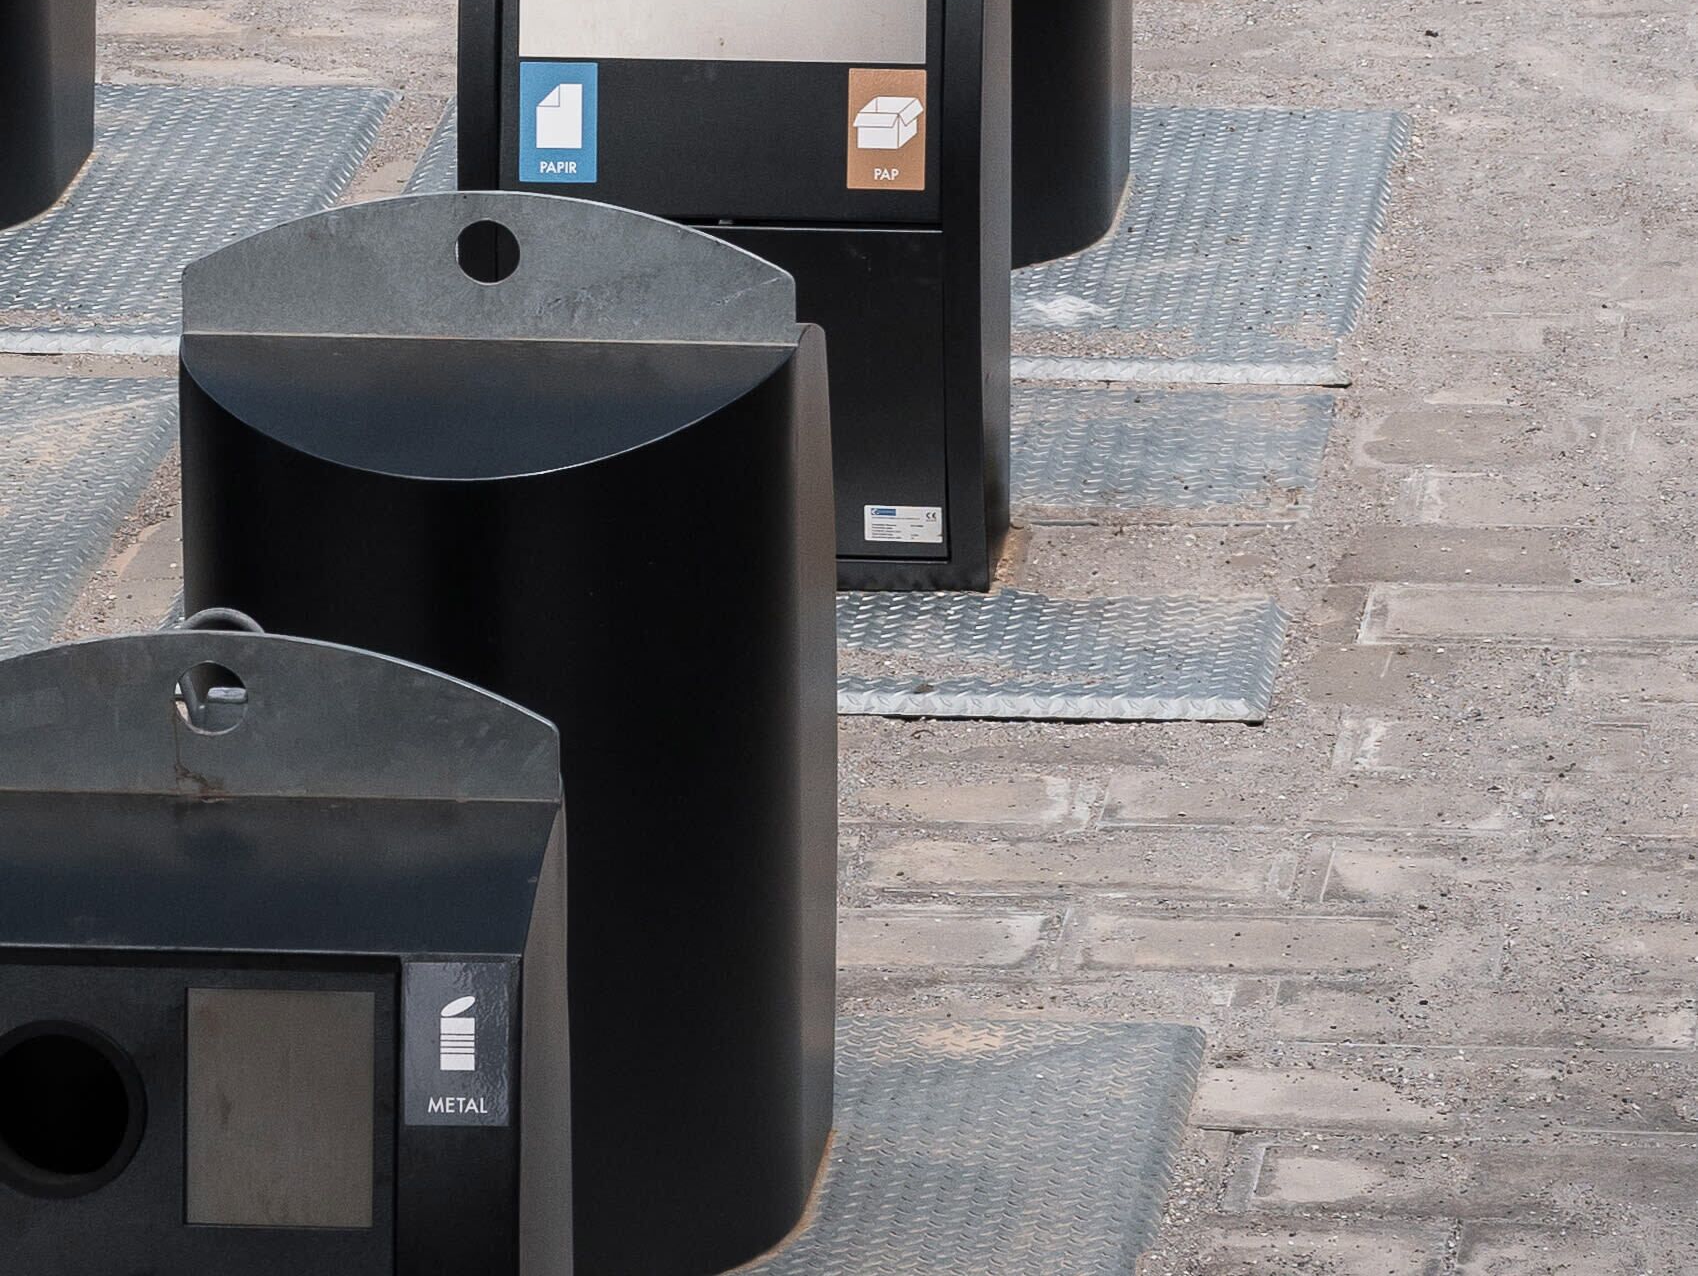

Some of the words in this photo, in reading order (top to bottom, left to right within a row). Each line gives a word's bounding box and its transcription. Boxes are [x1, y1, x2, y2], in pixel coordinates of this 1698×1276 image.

[539, 161, 577, 174] PAPIR
[874, 168, 899, 181] PAP
[427, 1096, 489, 1114] METAL
